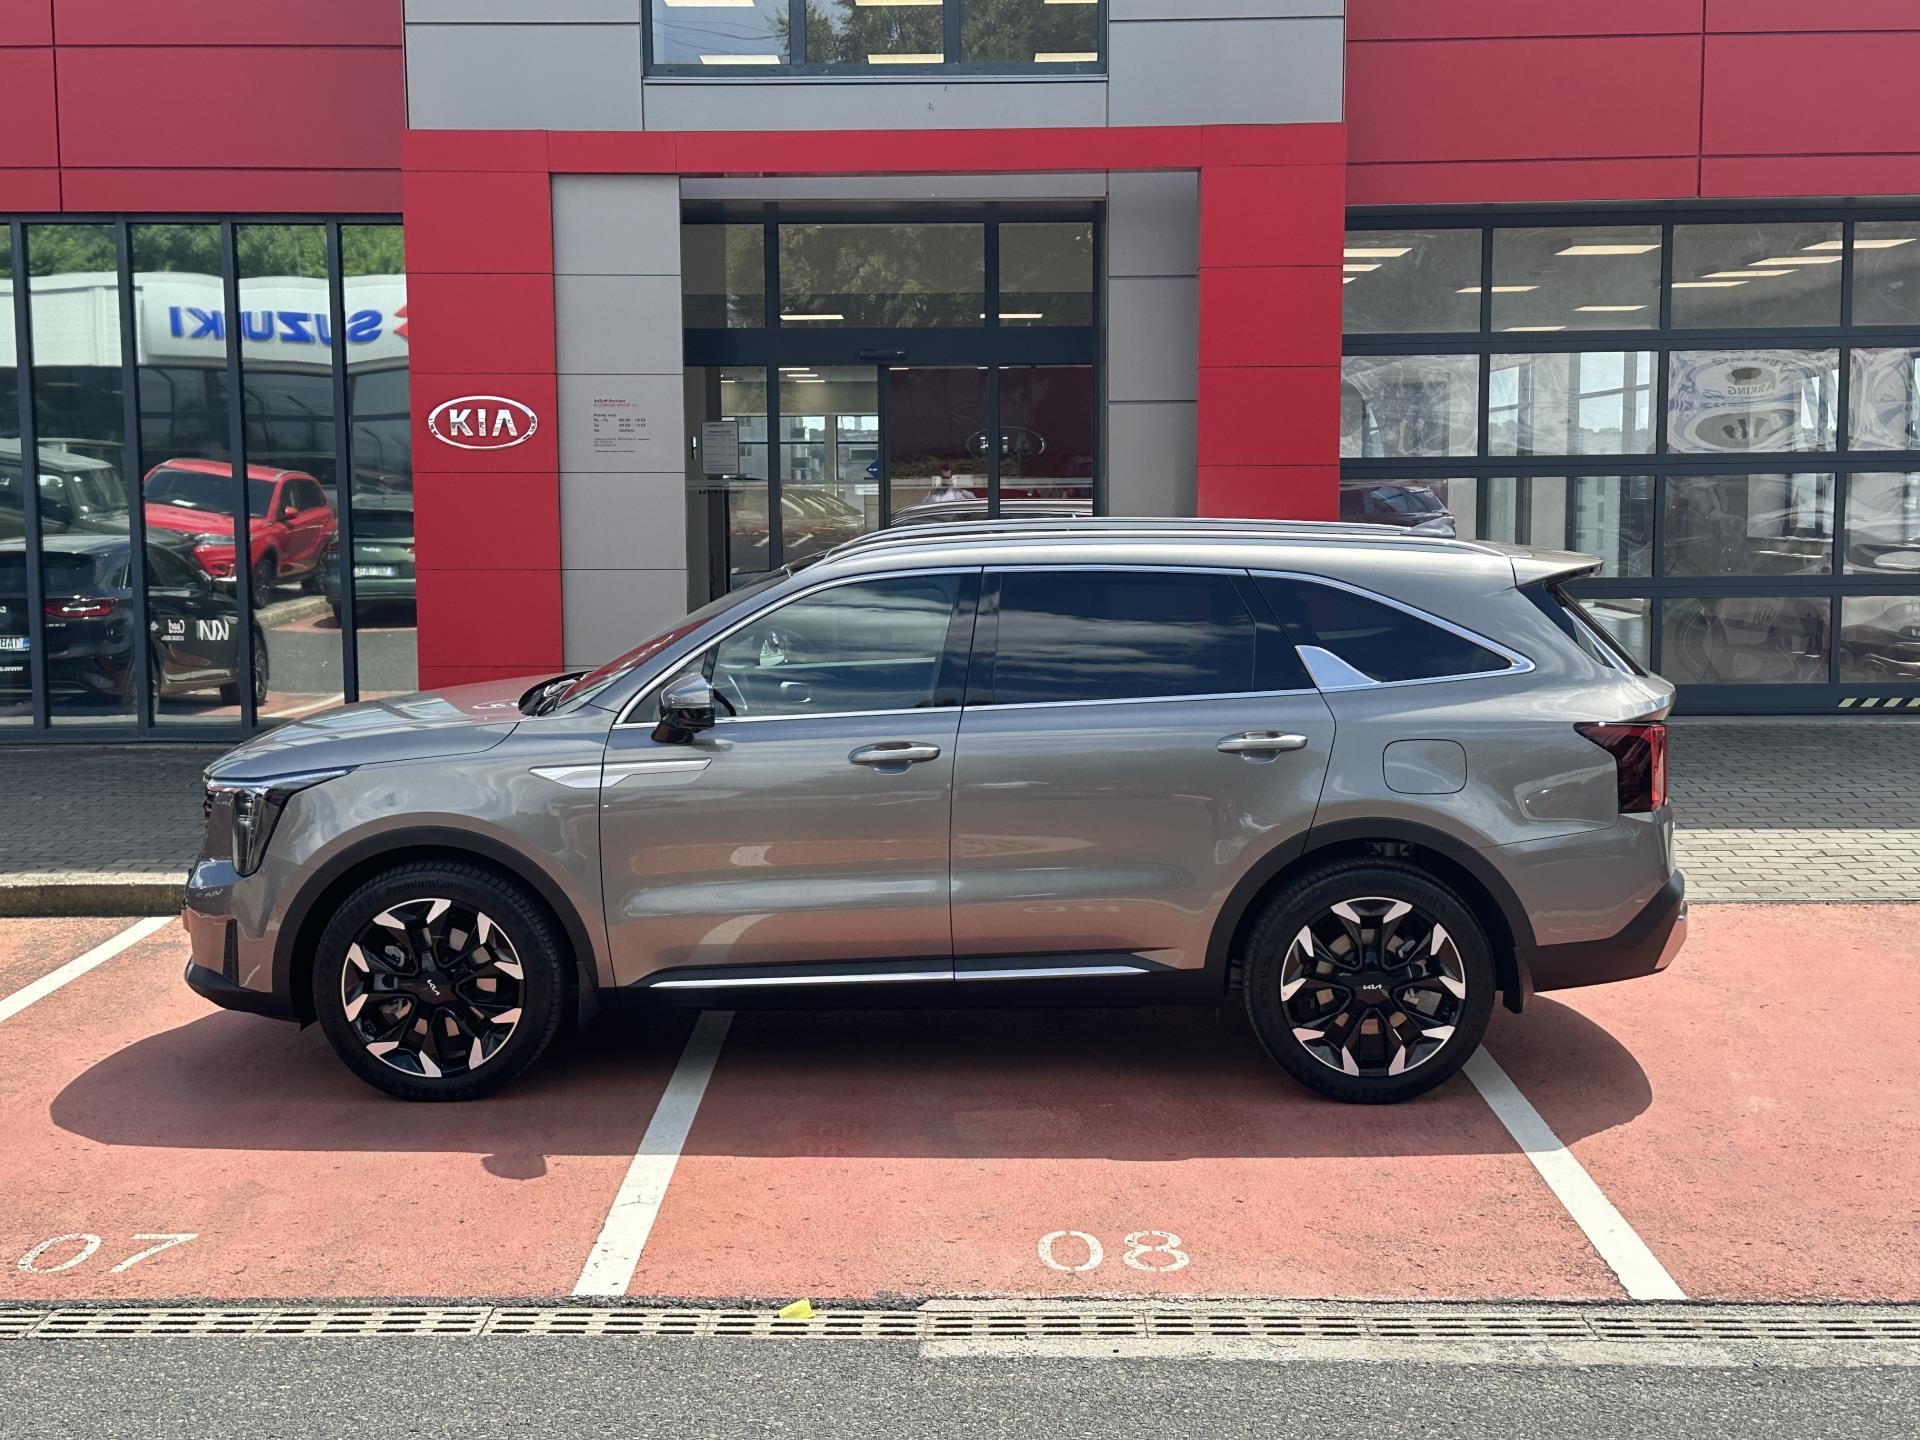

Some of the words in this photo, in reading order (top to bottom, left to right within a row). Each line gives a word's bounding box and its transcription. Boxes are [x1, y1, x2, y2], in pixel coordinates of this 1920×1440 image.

[449, 408, 518, 437] KIA
[17, 1232, 200, 1273] 07
[1037, 1230, 1190, 1272] 08
